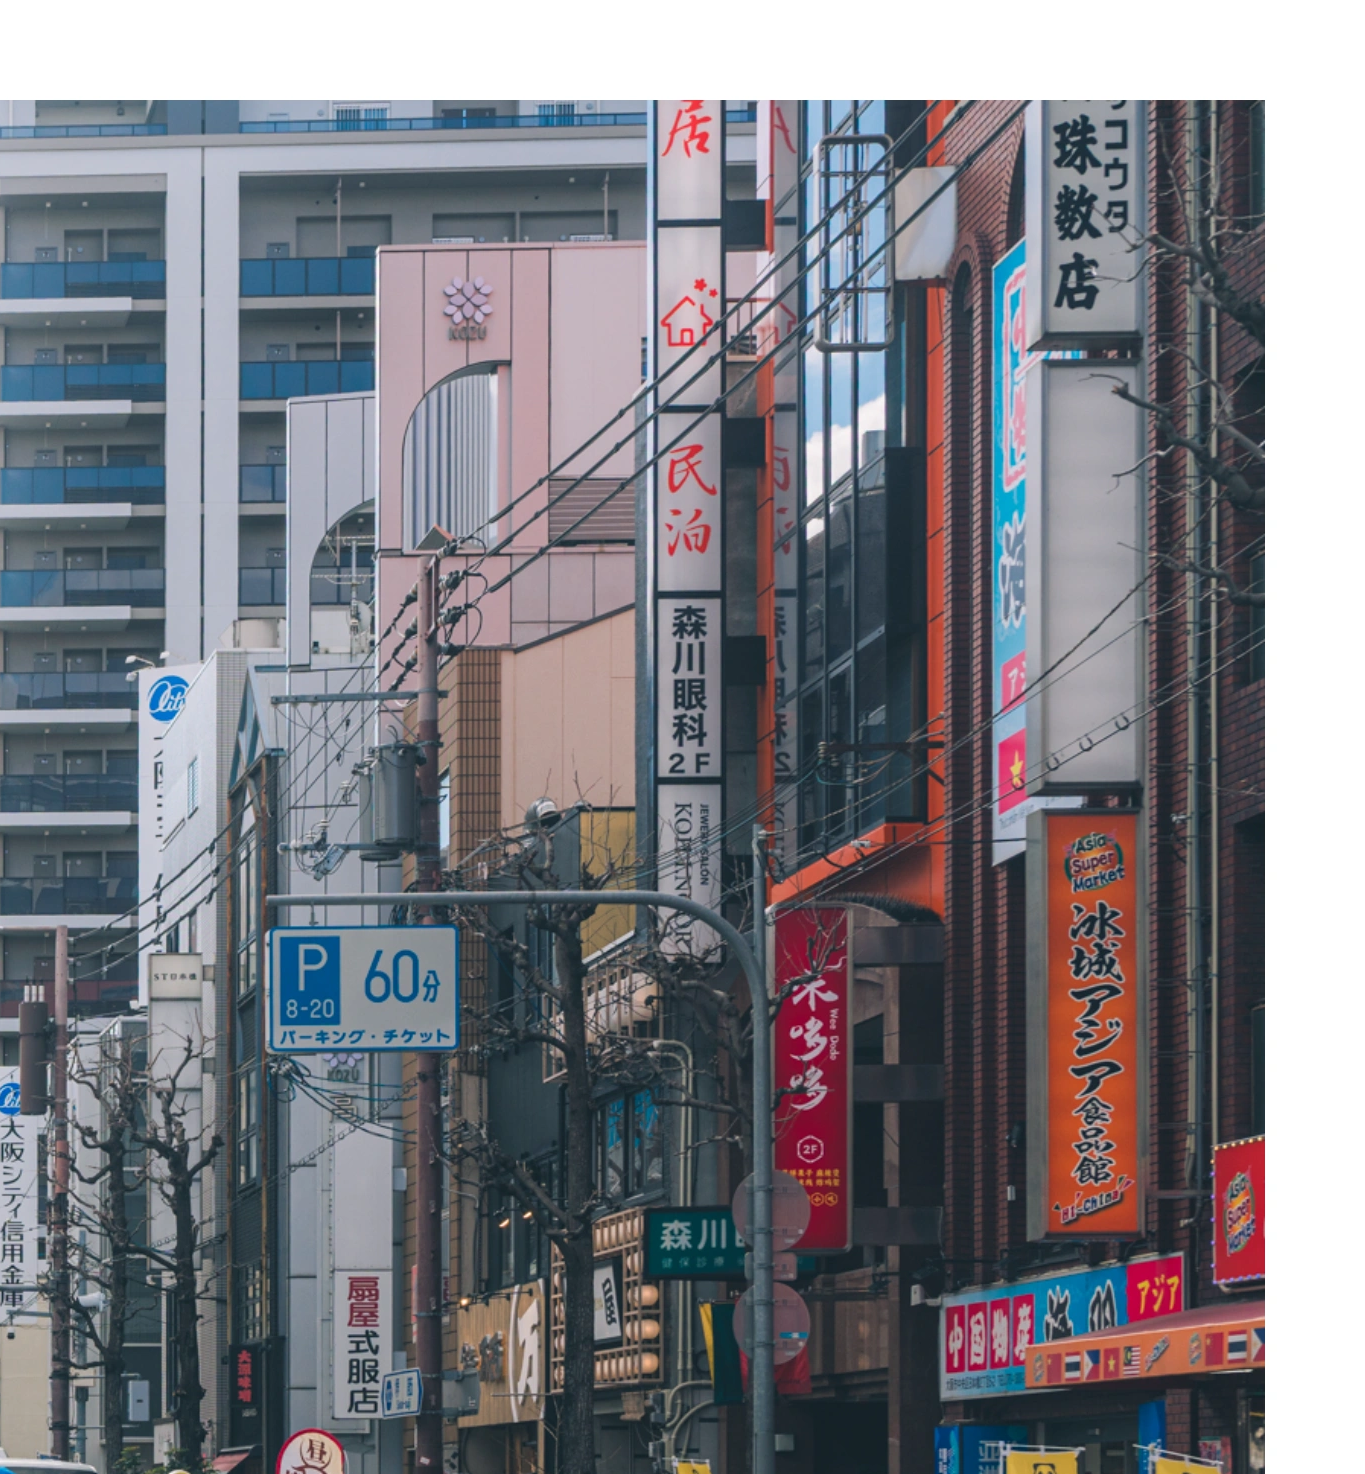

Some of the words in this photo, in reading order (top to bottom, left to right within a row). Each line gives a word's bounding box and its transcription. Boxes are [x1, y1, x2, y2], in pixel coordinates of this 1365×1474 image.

[1053, 100, 1103, 311] 珠数店
[448, 326, 487, 341] KOZU
[664, 443, 718, 558] 民泊
[671, 604, 709, 748] 森川眼科
[1075, 833, 1108, 855] Asia
[1071, 851, 1115, 876] Super
[1071, 865, 1126, 895] Market
[298, 944, 329, 992] P
[364, 949, 441, 1004] 60分
[286, 999, 335, 1019] 8-20
[279, 1028, 450, 1045] パーキング・チケット
[327, 1069, 360, 1082] KOZU
[803, 1144, 824, 1156] 2F
[1228, 1172, 1249, 1200] Asia
[0, 1118, 26, 1308] 大阪シティ信用金庫
[1226, 1197, 1251, 1229] Super
[1136, 1273, 1180, 1315] アジア
[346, 1275, 381, 1414] 扇屋式服店
[308, 1437, 327, 1466] 昼
